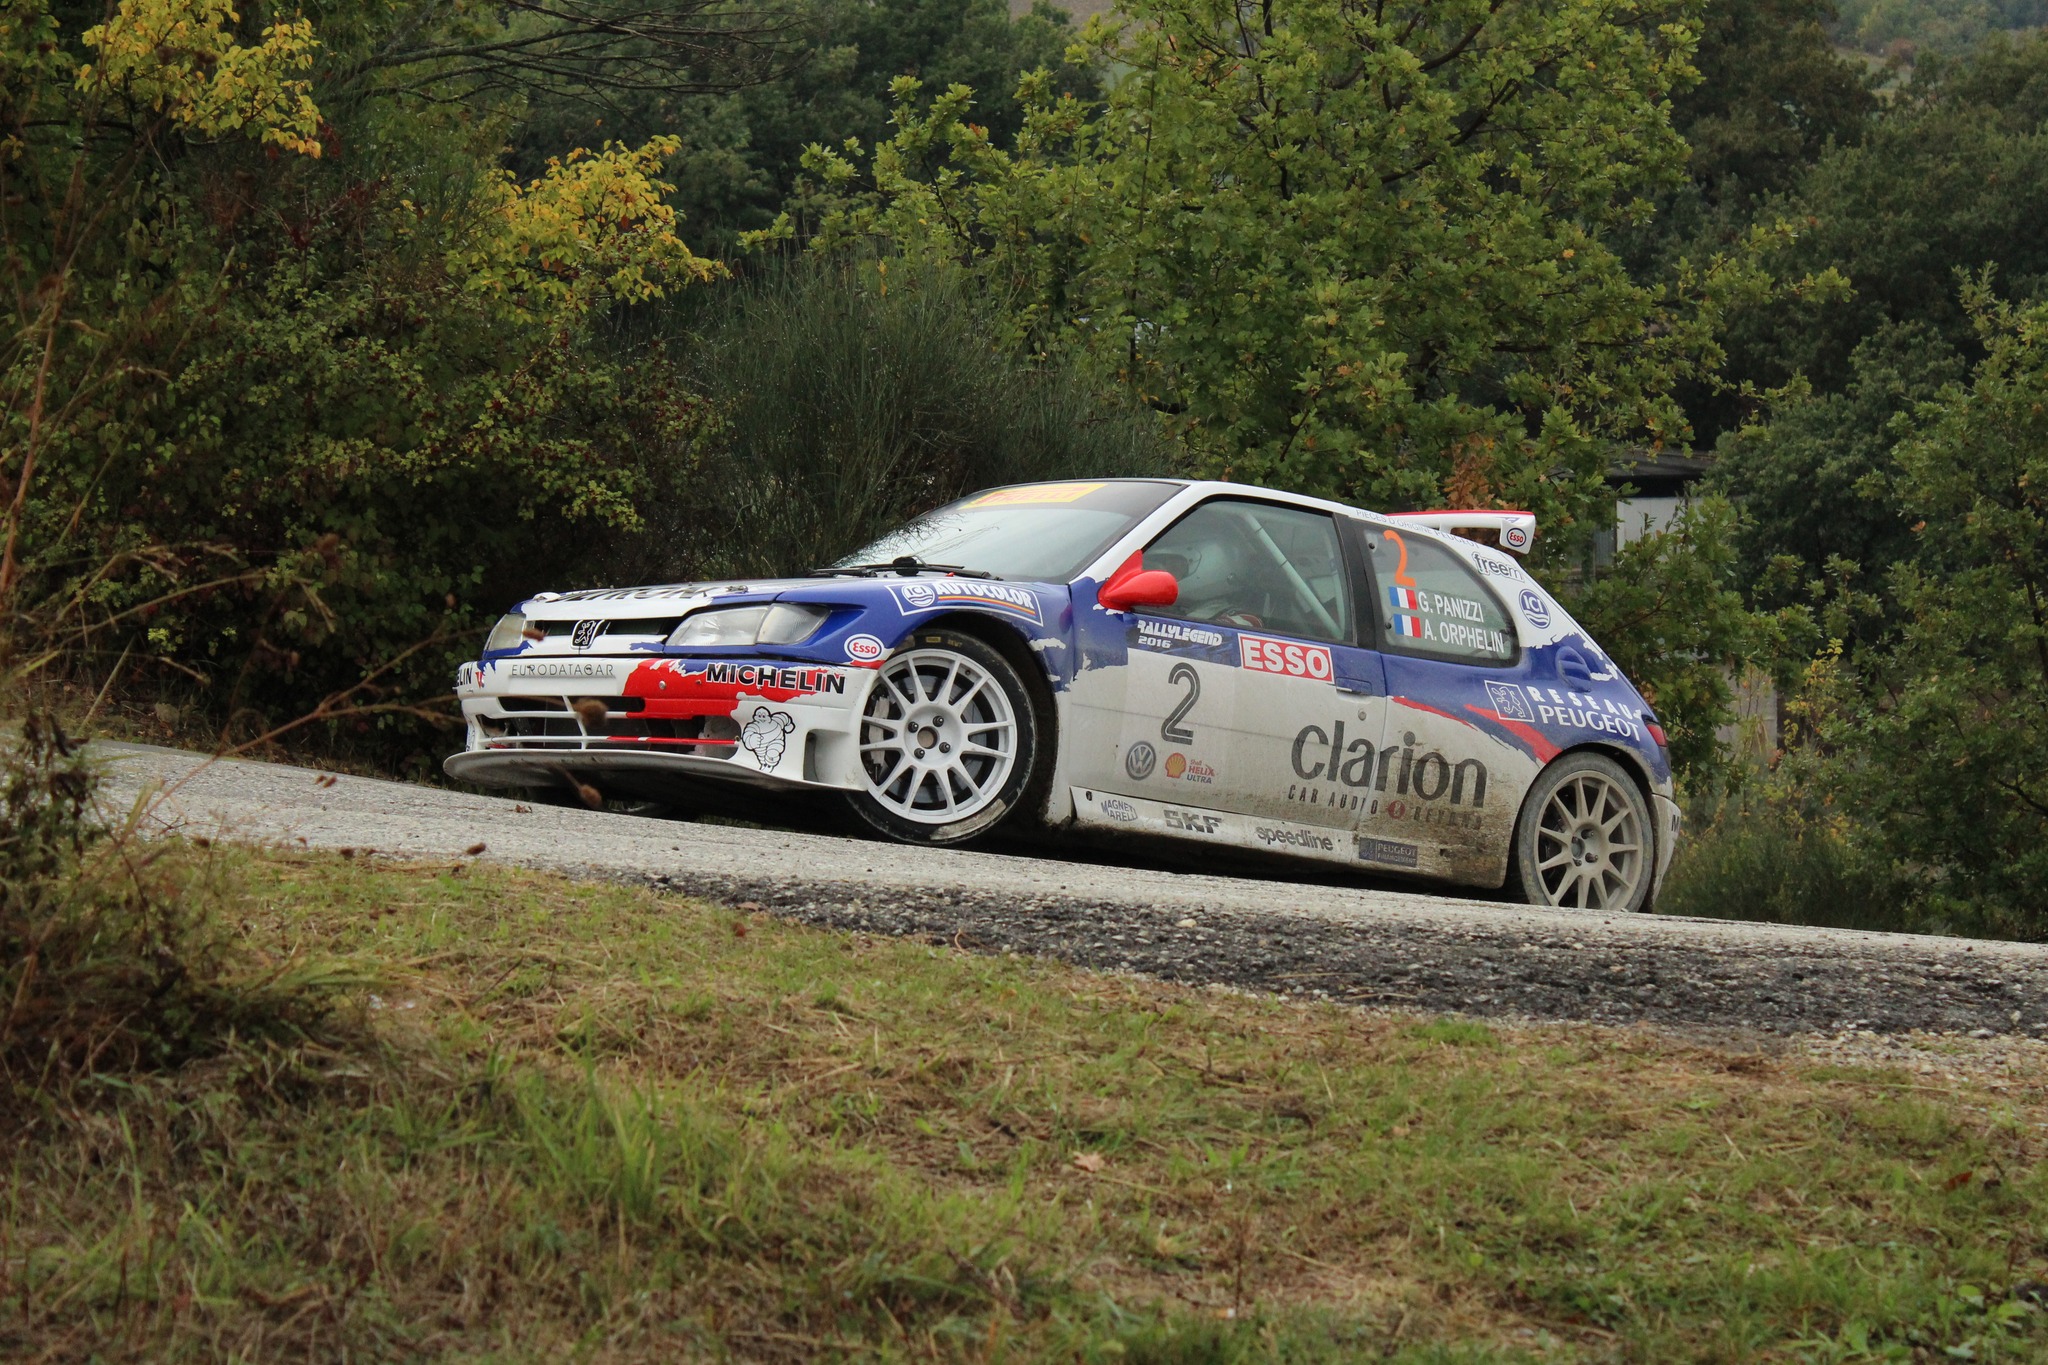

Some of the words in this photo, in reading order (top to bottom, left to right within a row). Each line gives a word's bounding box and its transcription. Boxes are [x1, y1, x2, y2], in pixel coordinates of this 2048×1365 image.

[1383, 529, 1416, 587] 2
[906, 586, 928, 596] ICI
[933, 582, 1035, 609] AUTOCOLOR
[1523, 594, 1543, 613] ICI
[1418, 593, 1433, 614] G.
[1436, 594, 1484, 623] PANIZZI
[1137, 620, 1222, 646] RALLYLEGEND
[1138, 635, 1172, 648] 2016
[1424, 620, 1437, 641] A.
[1440, 623, 1504, 653] ORPHELIN
[511, 664, 614, 676] EURODATACAR
[1243, 640, 1329, 679] ESSO
[706, 663, 845, 694] MICHELIN
[1161, 662, 1201, 745] 2
[1526, 686, 1633, 720] RESEAU
[1538, 705, 1640, 741] PEUGEOT
[1187, 774, 1212, 784] ULTRA
[1188, 766, 1215, 776] HELIX
[1288, 785, 1318, 804] CAR
[1328, 792, 1378, 815] AUDIO
[1163, 810, 1222, 834] SKF
[1256, 826, 1333, 851] speedline
[1378, 843, 1416, 857] PEUGEOT
